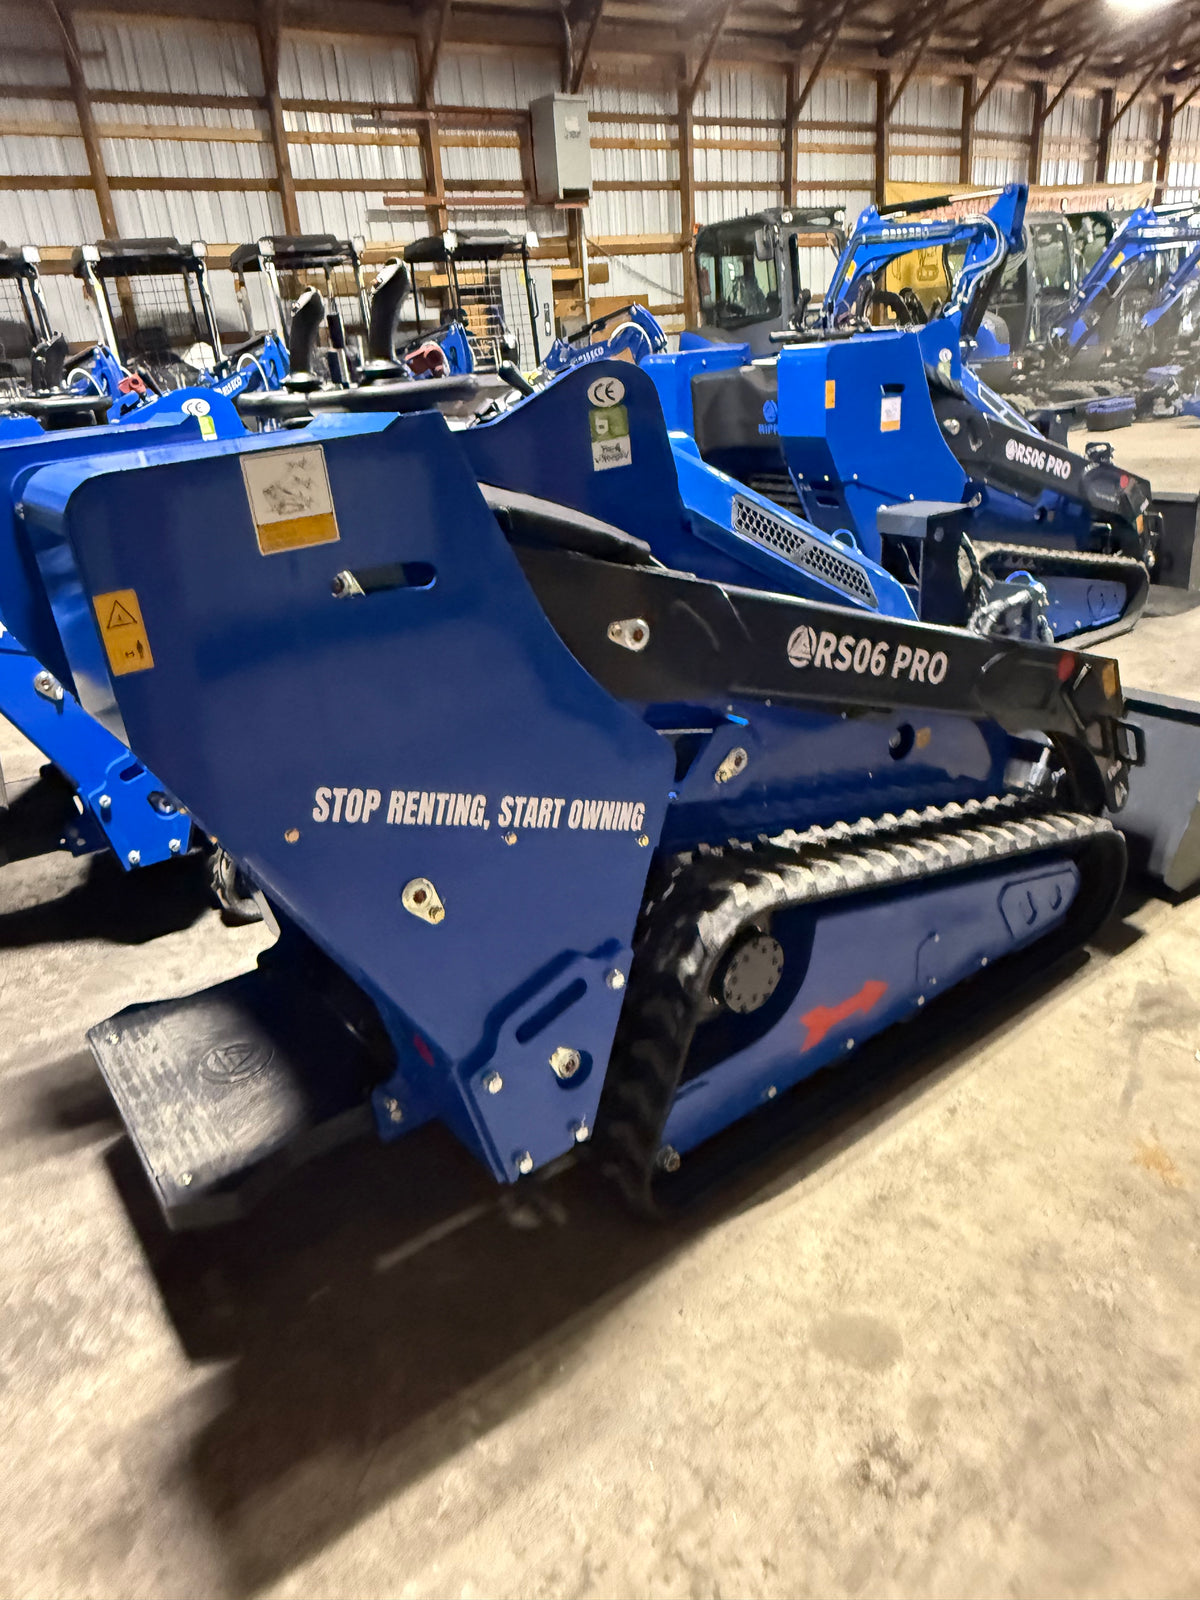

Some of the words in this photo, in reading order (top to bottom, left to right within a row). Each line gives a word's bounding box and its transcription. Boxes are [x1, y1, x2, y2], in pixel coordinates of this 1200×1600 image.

[1015, 442, 1047, 471] RS06
[1046, 454, 1071, 480] PRO
[814, 631, 890, 677] RS06
[891, 644, 948, 685] PRO
[312, 786, 382, 823] STOP
[387, 790, 490, 830] RENTING,
[498, 795, 565, 829] START
[567, 799, 646, 831] OWNING
